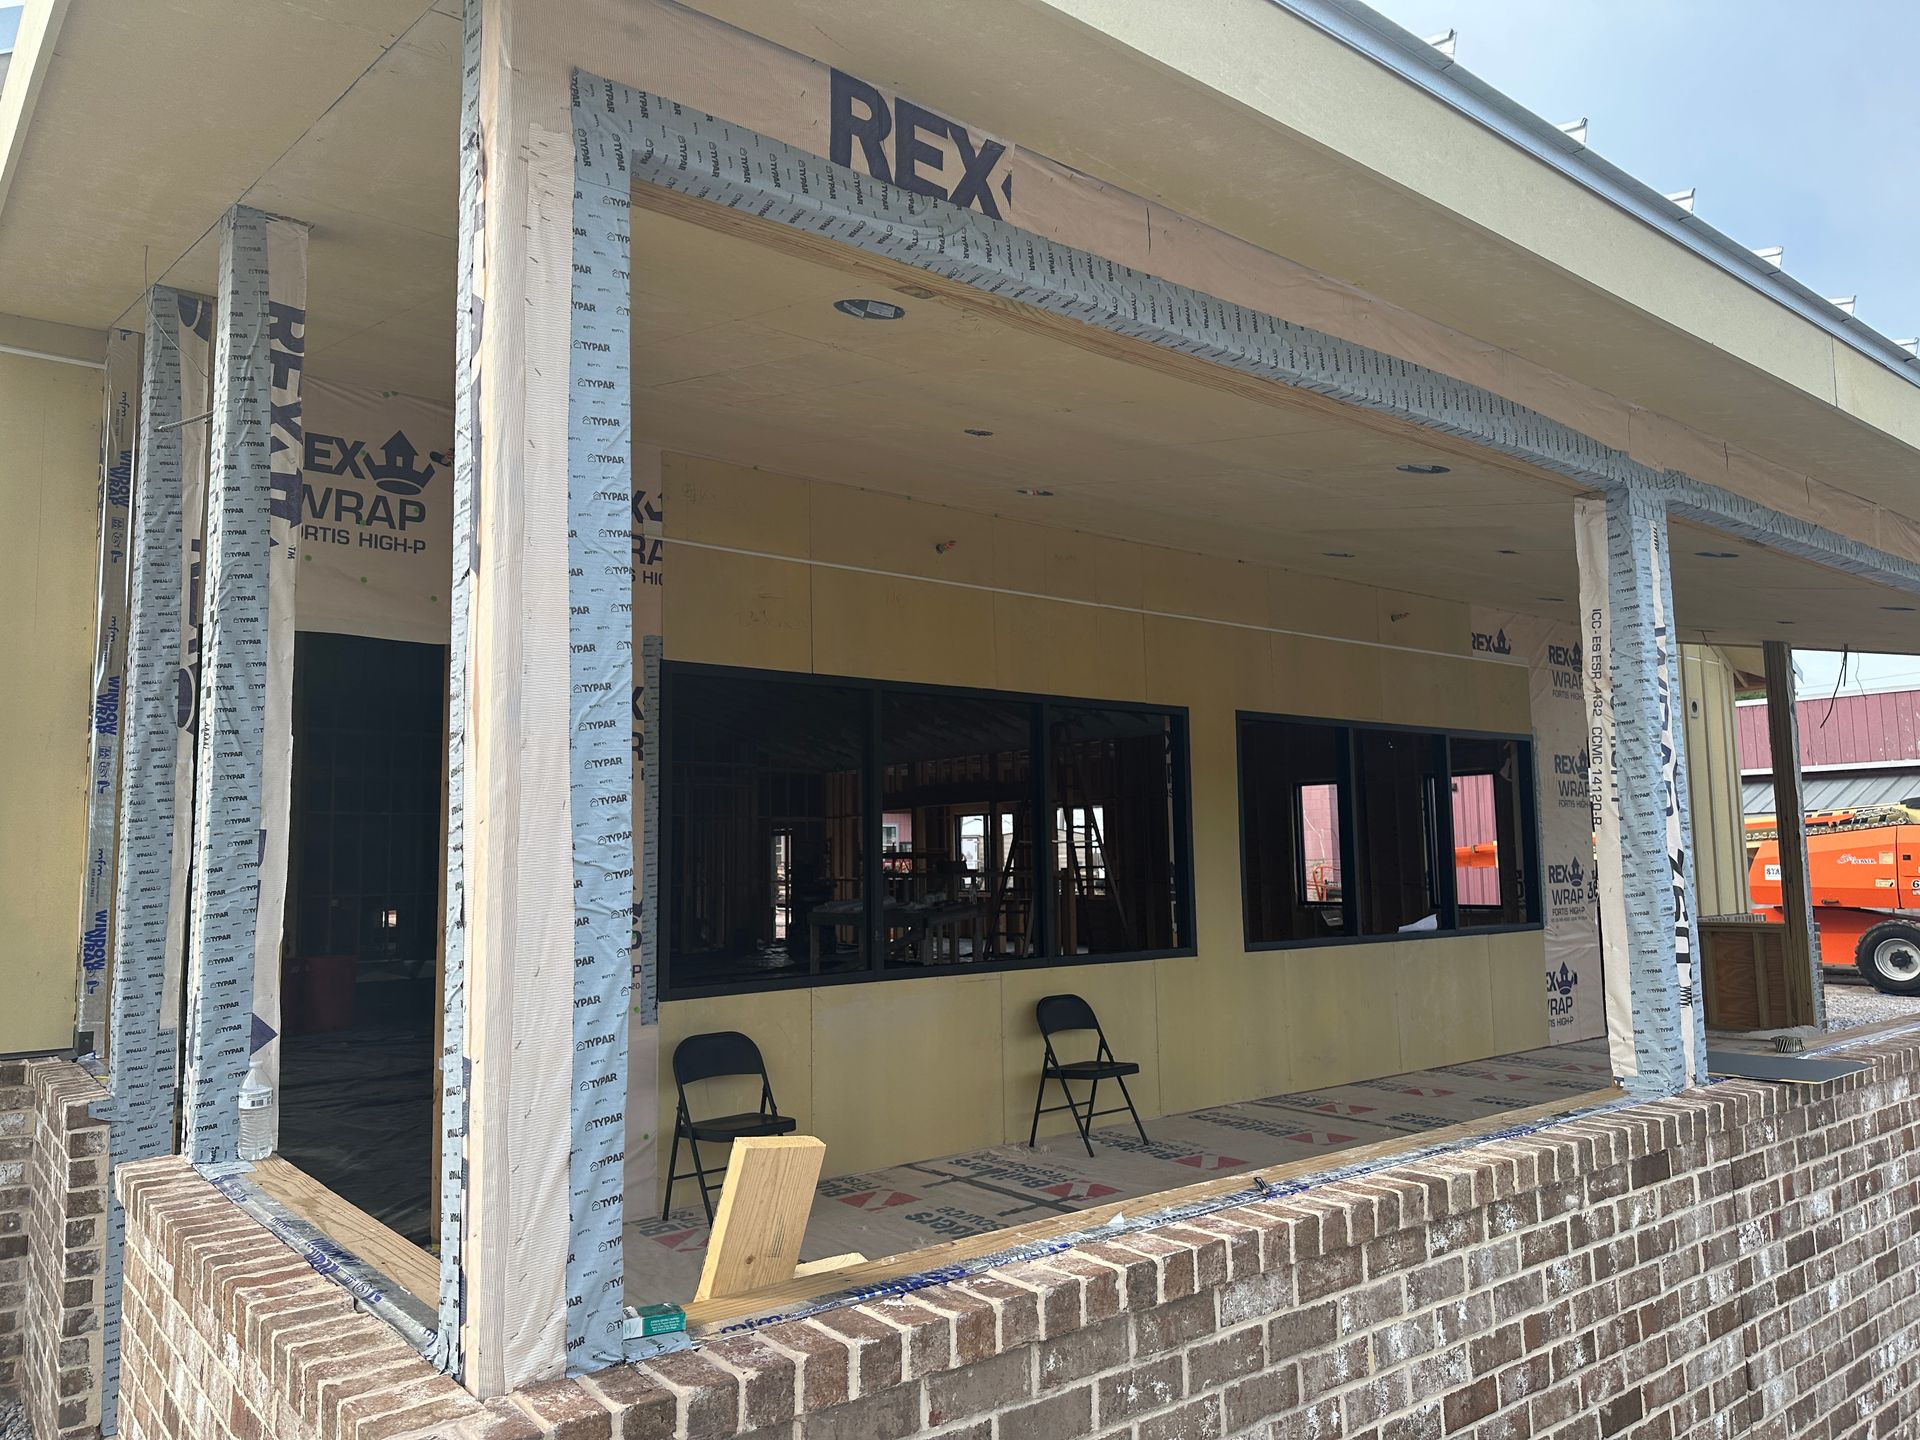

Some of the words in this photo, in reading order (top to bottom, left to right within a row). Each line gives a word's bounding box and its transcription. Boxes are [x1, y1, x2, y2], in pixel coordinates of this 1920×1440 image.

[571, 77, 580, 108] TYPAR
[639, 91, 648, 119] TYPAR
[830, 67, 1007, 220] REX
[581, 138, 591, 167] TYPAR
[613, 142, 625, 171] TYPAR
[678, 144, 688, 170] TYPAR
[711, 151, 719, 178] TYPAR
[740, 156, 750, 183] TYPAR
[770, 162, 781, 188] TYPAR
[800, 167, 808, 194] TYPAR
[827, 174, 836, 199] TYPAR
[854, 179, 863, 205] TYPAR
[611, 197, 630, 208] TYPA
[617, 233, 630, 243] TYP
[573, 264, 592, 275] PAR
[572, 301, 596, 312] YPAR
[581, 342, 610, 352] TYPAR
[585, 379, 615, 389] TYPAR
[591, 417, 620, 427] TYPAR
[304, 432, 367, 480] EX
[596, 454, 624, 464] TYPAR
[118, 449, 131, 508] WINDOW
[601, 492, 628, 501] TYPAR
[301, 524, 350, 545] RTIS
[359, 532, 426, 554] HIGH-P
[607, 529, 632, 537] TYPAR
[572, 606, 590, 615] PAR
[571, 644, 595, 653] YPAR
[1549, 645, 1572, 667] REX
[582, 683, 611, 692] TYPAR
[107, 675, 120, 736] WINDOW
[587, 720, 616, 729] TYPAR
[1591, 726, 1603, 765] CCMC
[593, 757, 622, 768] TYPAR
[1554, 754, 1576, 775] REX
[599, 794, 627, 804] TYPAR
[606, 831, 632, 842] TYPAR
[613, 868, 633, 878] TYPA
[1549, 865, 1569, 885] REX
[1552, 888, 1584, 906] WRAP
[620, 907, 633, 916] TYP
[1552, 907, 1569, 917] FORTIS
[575, 956, 595, 966] PAR
[574, 996, 601, 1007] YPAR
[1548, 996, 1574, 1017] RAP
[222, 1024, 242, 1032] TYPAR
[585, 1034, 615, 1048] TYPAR
[589, 1073, 617, 1088] TYPAR
[593, 1113, 623, 1127] TYPAR
[197, 1123, 218, 1131] TYPAR
[599, 1152, 624, 1167] TYPAR
[601, 1196, 623, 1209] TYPA
[607, 1236, 622, 1248] TYP
[568, 1337, 585, 1350] PAR
